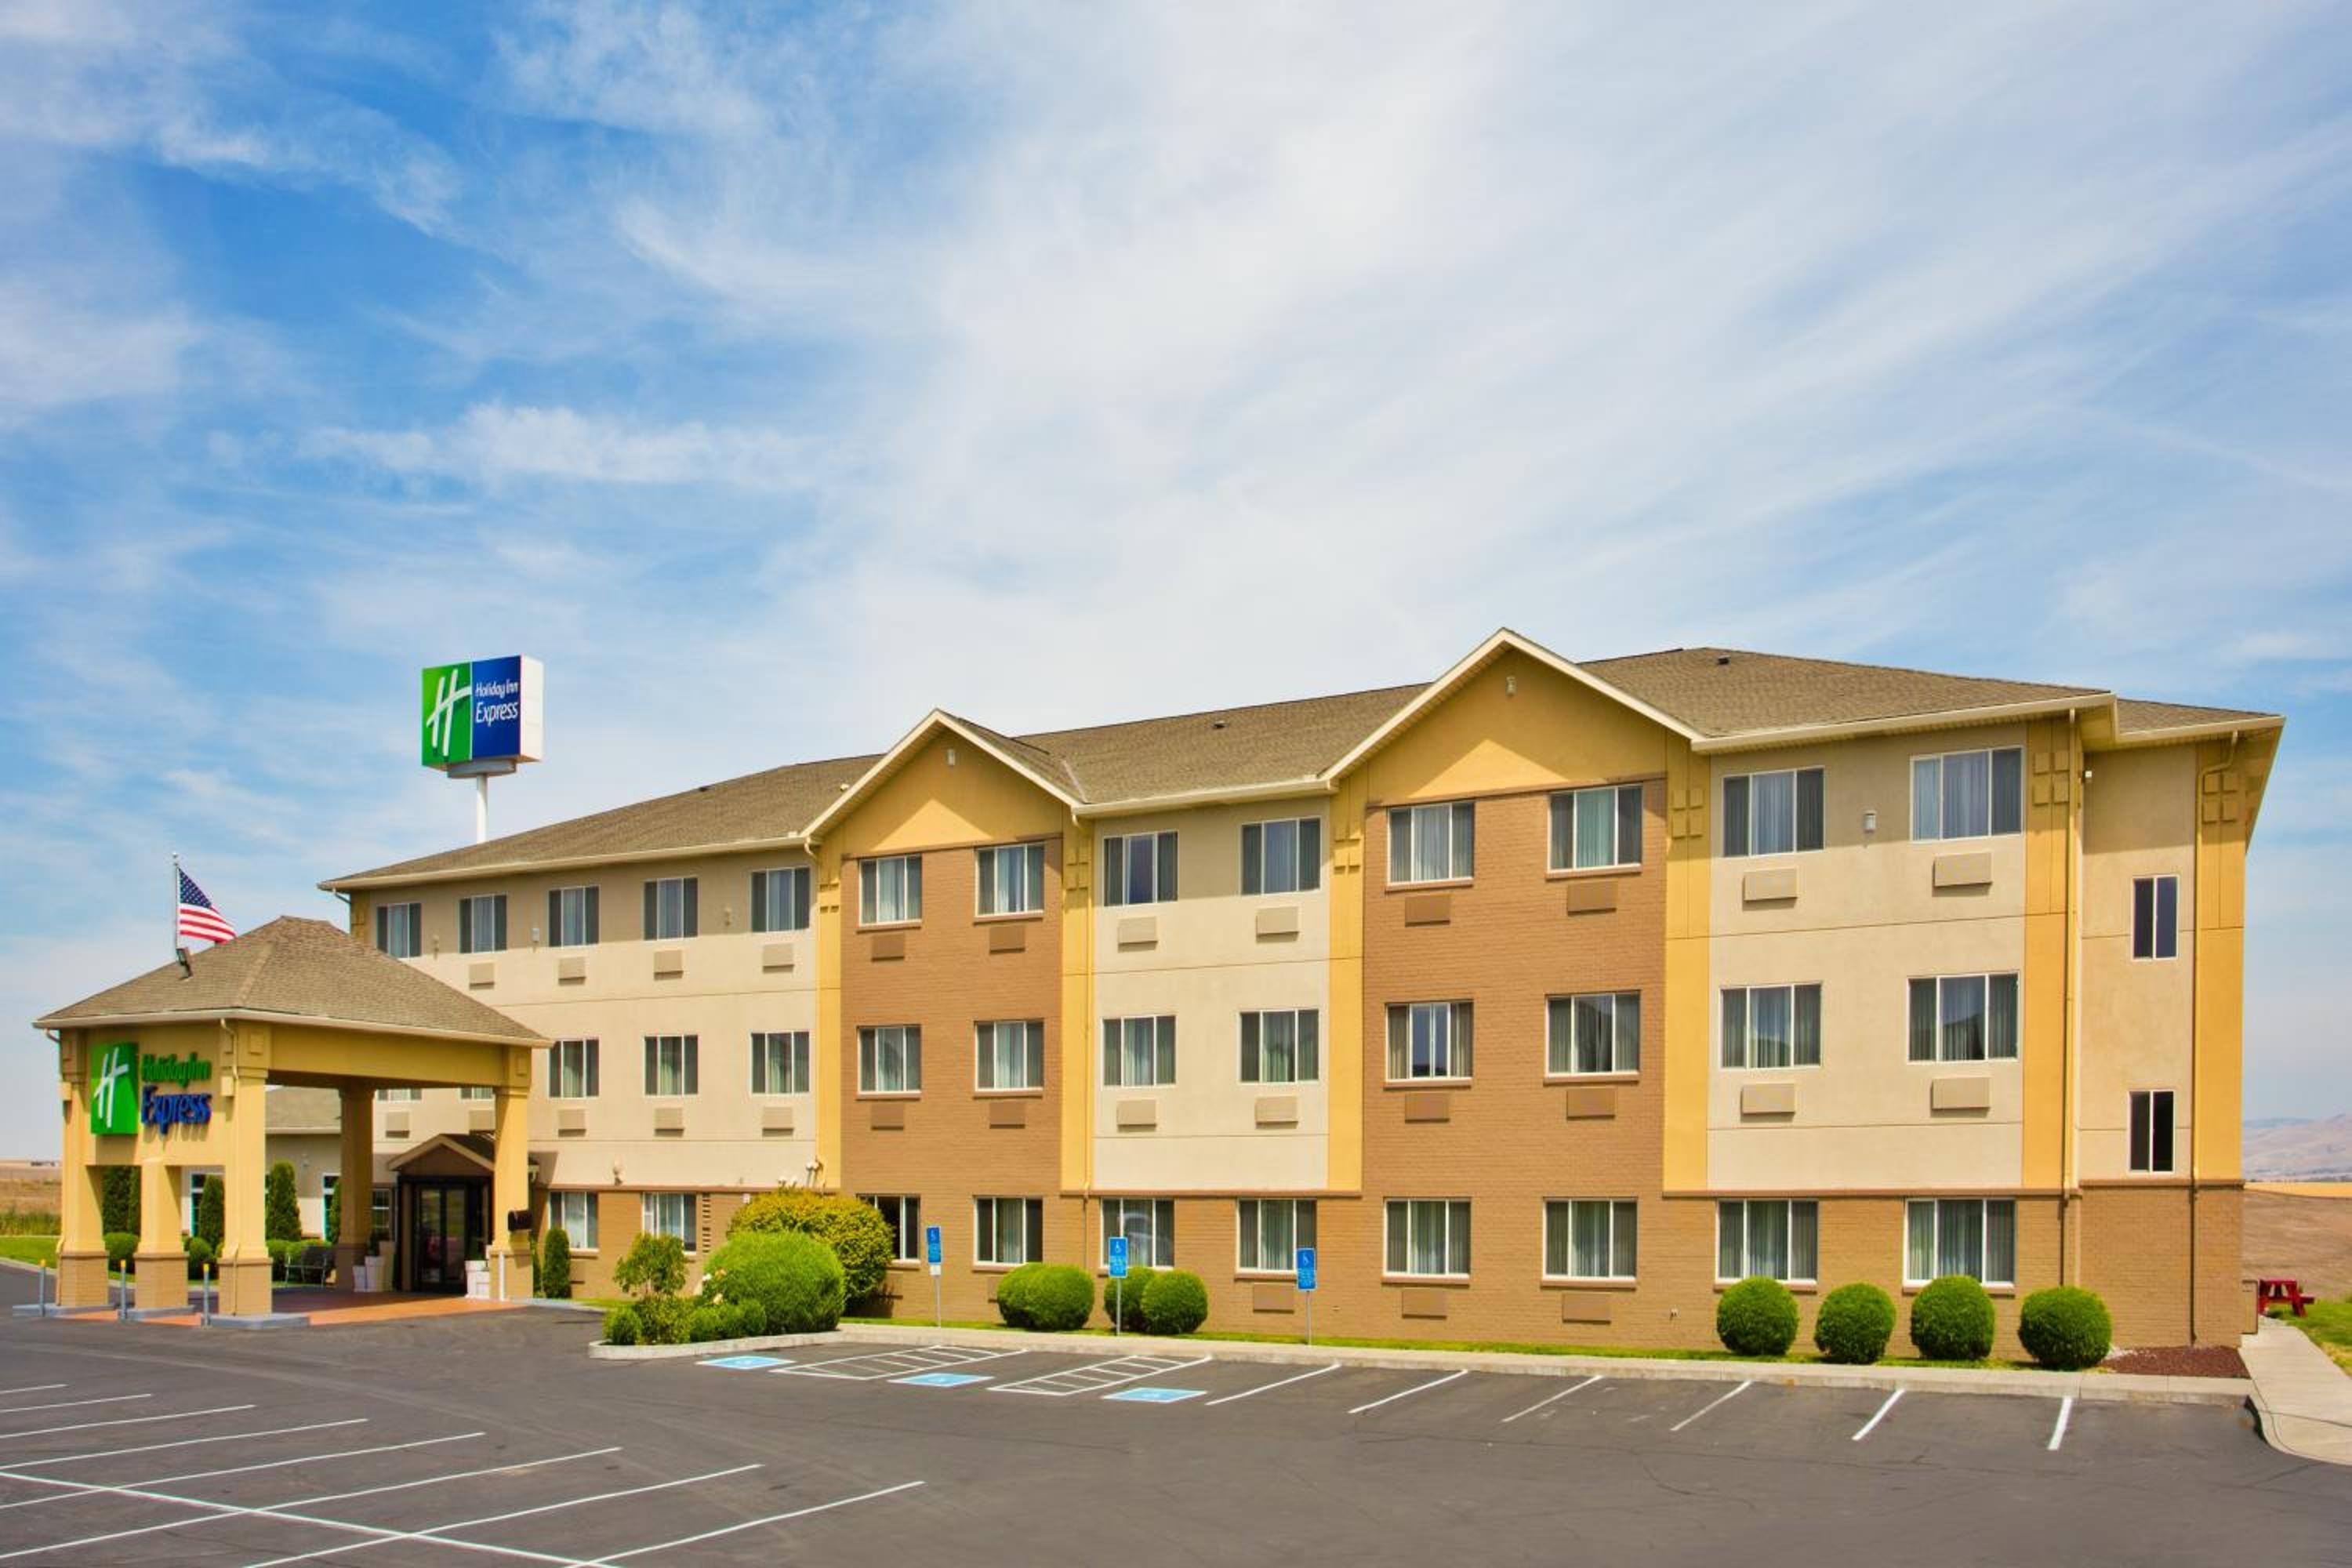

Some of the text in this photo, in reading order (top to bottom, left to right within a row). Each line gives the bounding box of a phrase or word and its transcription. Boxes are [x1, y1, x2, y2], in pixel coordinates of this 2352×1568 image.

[475, 679, 518, 699] Holiday Inn
[475, 702, 518, 727] Express
[142, 1053, 189, 1088] Holiday
[141, 1085, 212, 1135] Express
